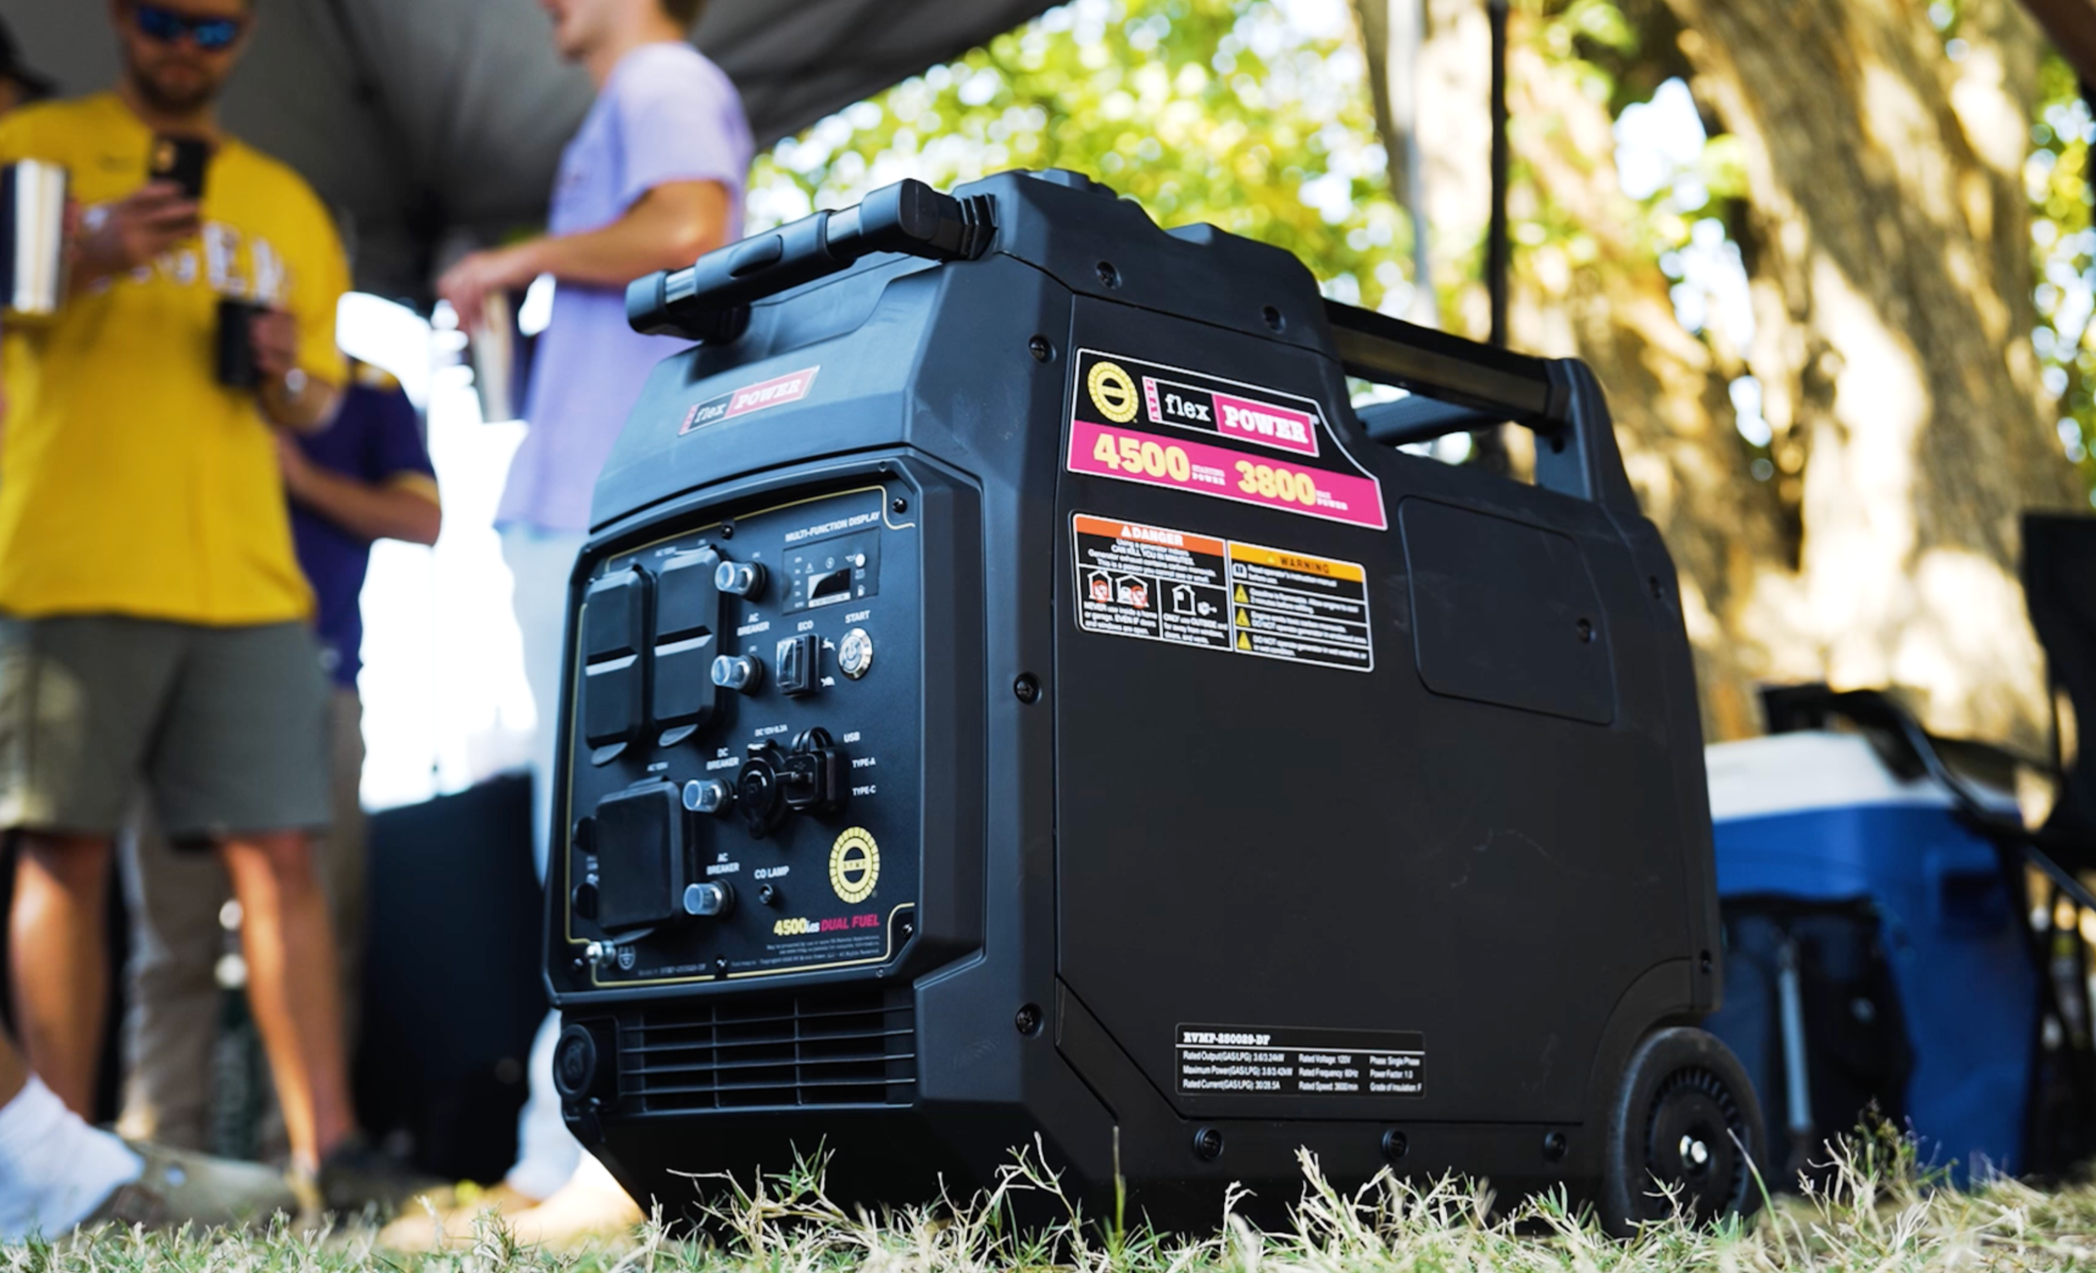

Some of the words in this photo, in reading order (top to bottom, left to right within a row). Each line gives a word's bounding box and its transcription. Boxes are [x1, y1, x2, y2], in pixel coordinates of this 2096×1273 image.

[693, 403, 727, 424] flex
[733, 379, 802, 410] POWER
[1165, 393, 1211, 422] flex
[1222, 405, 1309, 444] POWER
[1093, 433, 1190, 482] 4500
[1192, 473, 1226, 486] POWER
[1235, 460, 1316, 506] 3800
[785, 519, 847, 542] MULTI-FUNCTION
[848, 511, 880, 526] DISPLAY
[1132, 526, 1183, 546] DANGER
[1280, 557, 1330, 574] WARNING
[748, 613, 759, 623] AC
[845, 610, 871, 624] START
[737, 621, 770, 636] BREAKER
[797, 620, 814, 631] ECO
[843, 731, 861, 743] USB
[717, 748, 729, 758] DC
[706, 757, 740, 771] BREAKER
[852, 757, 876, 768] TYPE-A
[852, 785, 877, 796] TYPE-C
[717, 852, 728, 862] AC
[706, 862, 740, 876] BREAKER
[754, 868, 767, 879] CO
[767, 866, 790, 878] LAMP
[820, 918, 850, 932] DUAL
[852, 914, 880, 928] FUEL
